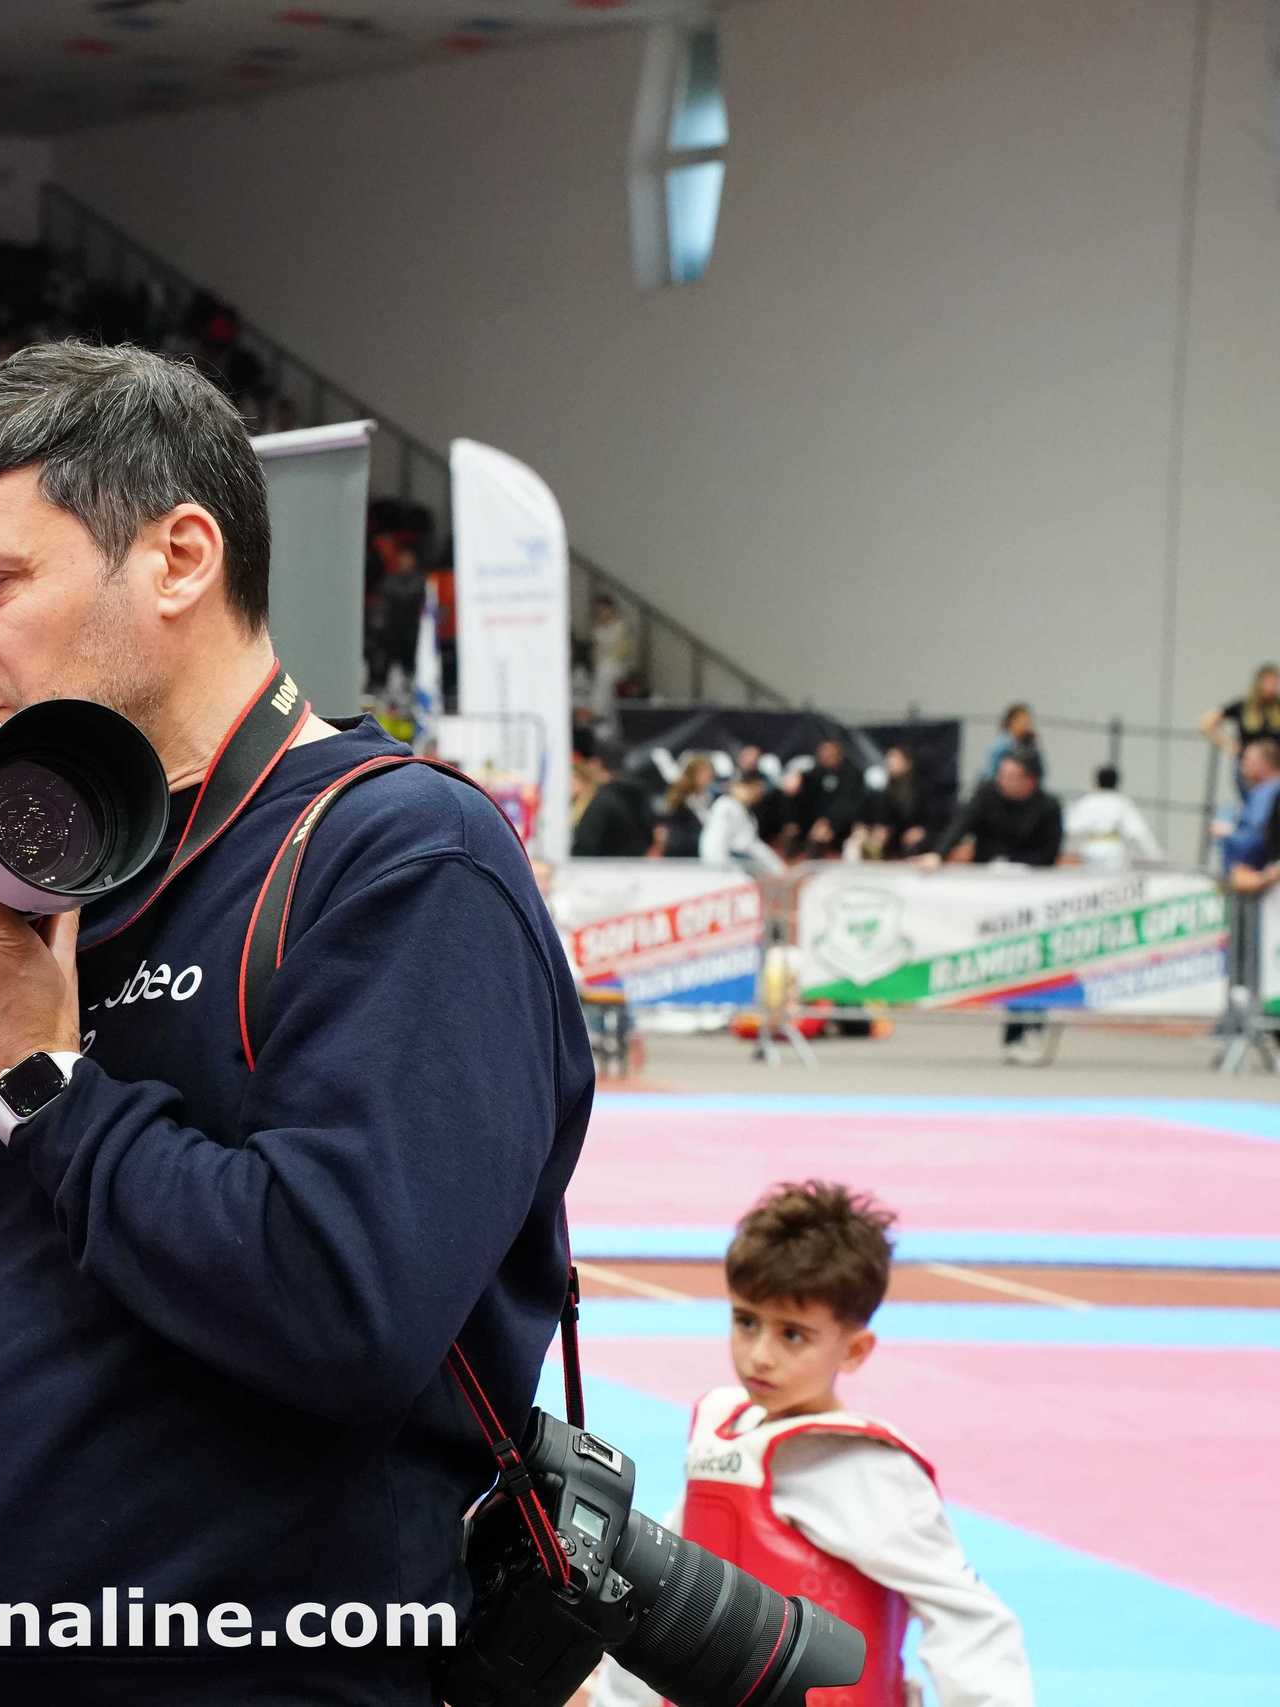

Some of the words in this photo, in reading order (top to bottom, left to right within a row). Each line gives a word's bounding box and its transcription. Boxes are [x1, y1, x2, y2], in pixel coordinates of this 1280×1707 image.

[581, 909, 672, 965] SOFIA
[677, 891, 761, 938] OPEN
[1049, 913, 1138, 963] SOFIA
[1143, 895, 1224, 942] OPEN
